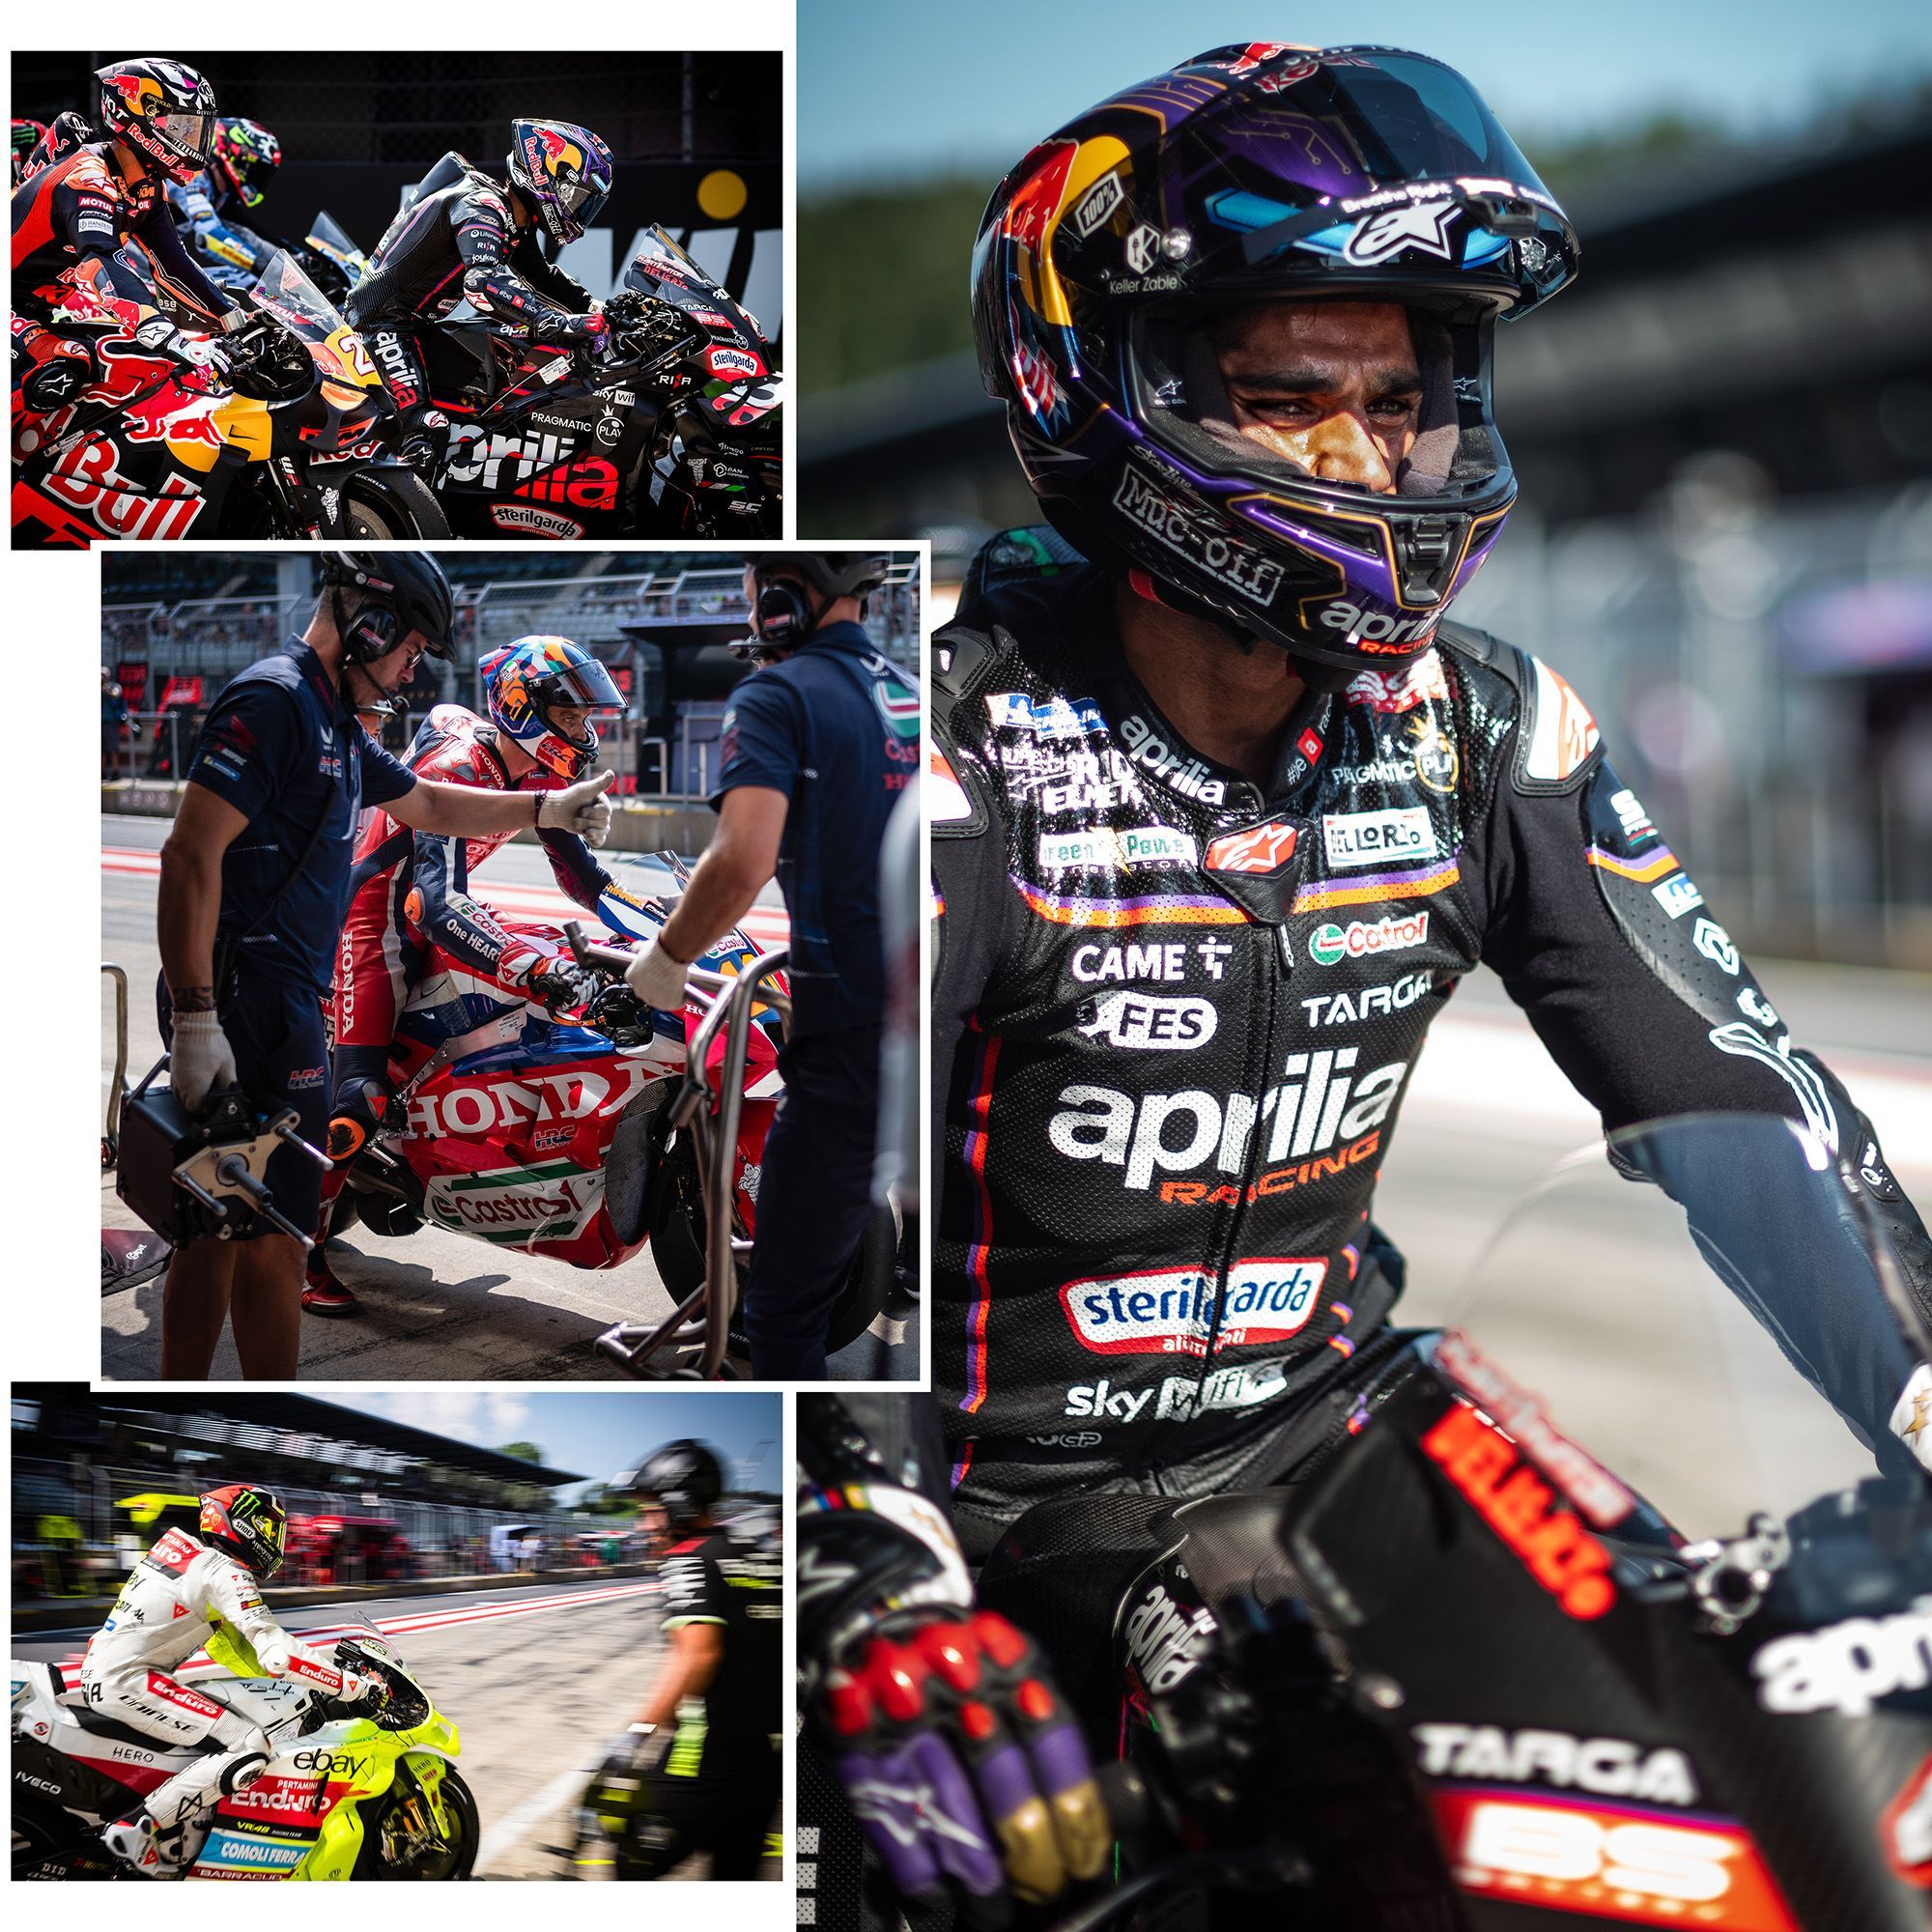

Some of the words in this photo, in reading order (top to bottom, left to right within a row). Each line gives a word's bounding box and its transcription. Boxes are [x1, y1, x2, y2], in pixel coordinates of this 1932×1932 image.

[127, 123, 156, 151] Red
[149, 142, 180, 167] Bull
[525, 136, 541, 164] Red
[530, 160, 549, 185] Bull
[79, 198, 114, 213] MOTUL
[1081, 182, 1117, 230] 100%
[1109, 278, 1141, 296] Keller
[1143, 275, 1179, 292] Zable
[375, 331, 418, 410] aprilia
[713, 352, 754, 371] sterilgarda
[592, 390, 613, 401] sky
[531, 412, 592, 432] PRAGMATIC
[599, 426, 622, 438] PLAY
[355, 473, 386, 491] MICHELIN
[497, 507, 576, 536] sterilgarda
[477, 749, 504, 789] HONDA
[1121, 715, 1227, 806] aprilia
[446, 918, 468, 939] One
[1072, 945, 1185, 981] CAME
[342, 931, 354, 1037] HONDA
[1118, 1003, 1204, 1040] FES
[408, 1061, 674, 1139] HONDA
[1048, 1048, 1407, 1190] aprilia
[1159, 1131, 1380, 1206] RACING
[455, 1179, 582, 1224] Castrol
[1084, 1268, 1312, 1334] sterilgarda
[1065, 1379, 1154, 1423] sky
[236, 1520, 254, 1537] SHOEI
[299, 1664, 339, 1687] Enduro
[153, 1680, 218, 1715] Enduro
[112, 1746, 155, 1763] HERO
[294, 1747, 367, 1779] ebay
[1414, 1723, 1698, 1805] TARGA
[14, 1770, 62, 1795] IVECO
[231, 1787, 331, 1813] Enduro
[221, 1842, 268, 1862] COMOLI
[268, 1847, 305, 1864] FERRA
[1465, 1804, 1742, 1901] BS
